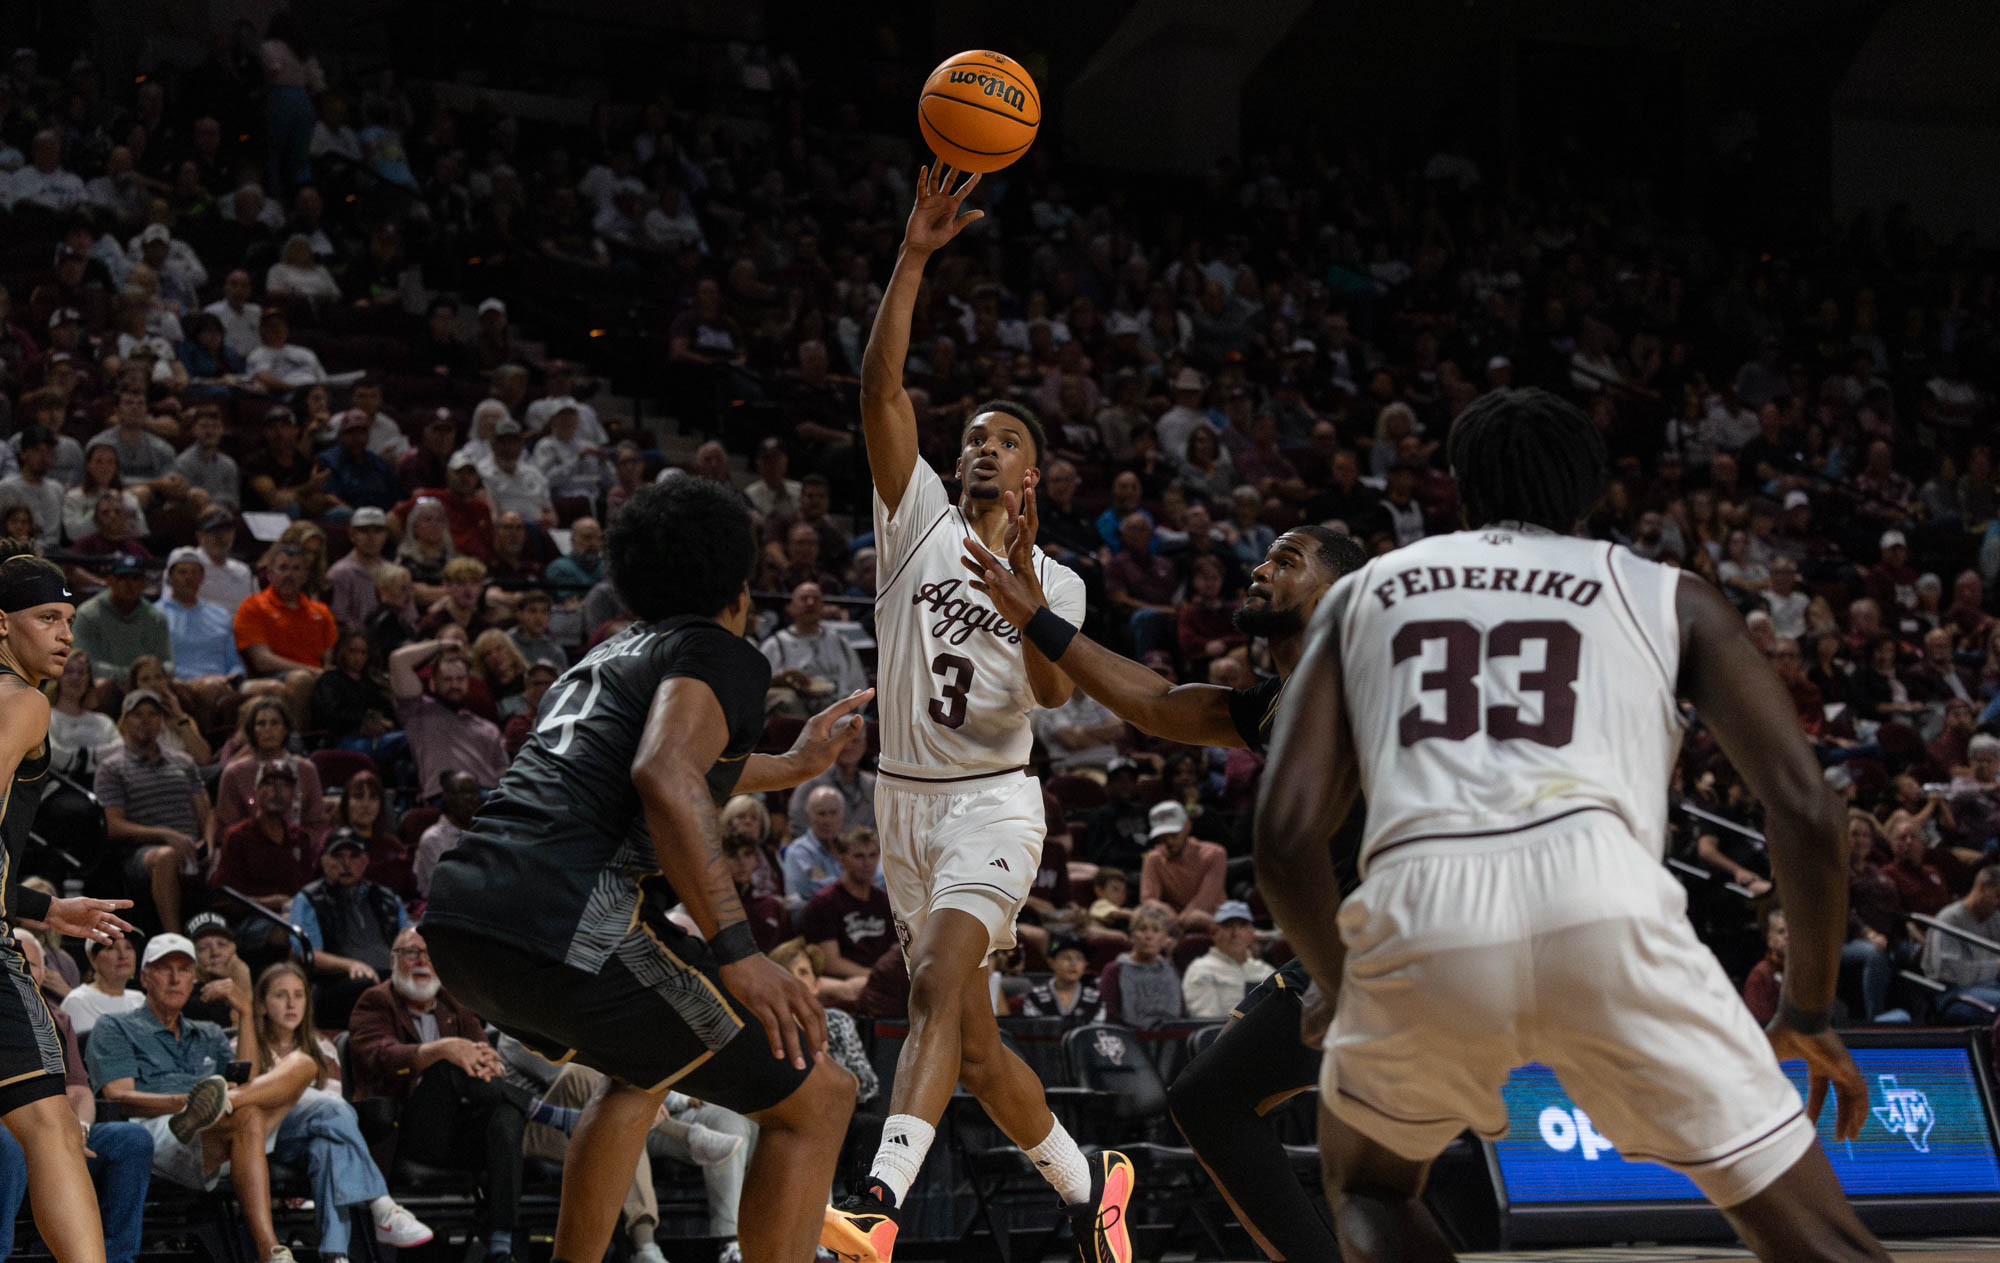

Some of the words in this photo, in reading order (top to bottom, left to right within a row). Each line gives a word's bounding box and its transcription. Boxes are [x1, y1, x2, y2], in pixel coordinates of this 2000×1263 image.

[949, 70, 1026, 113] Wilson
[1373, 566, 1603, 609] FEDERIKO
[928, 652, 975, 730] 3
[1392, 619, 1582, 749] 33
